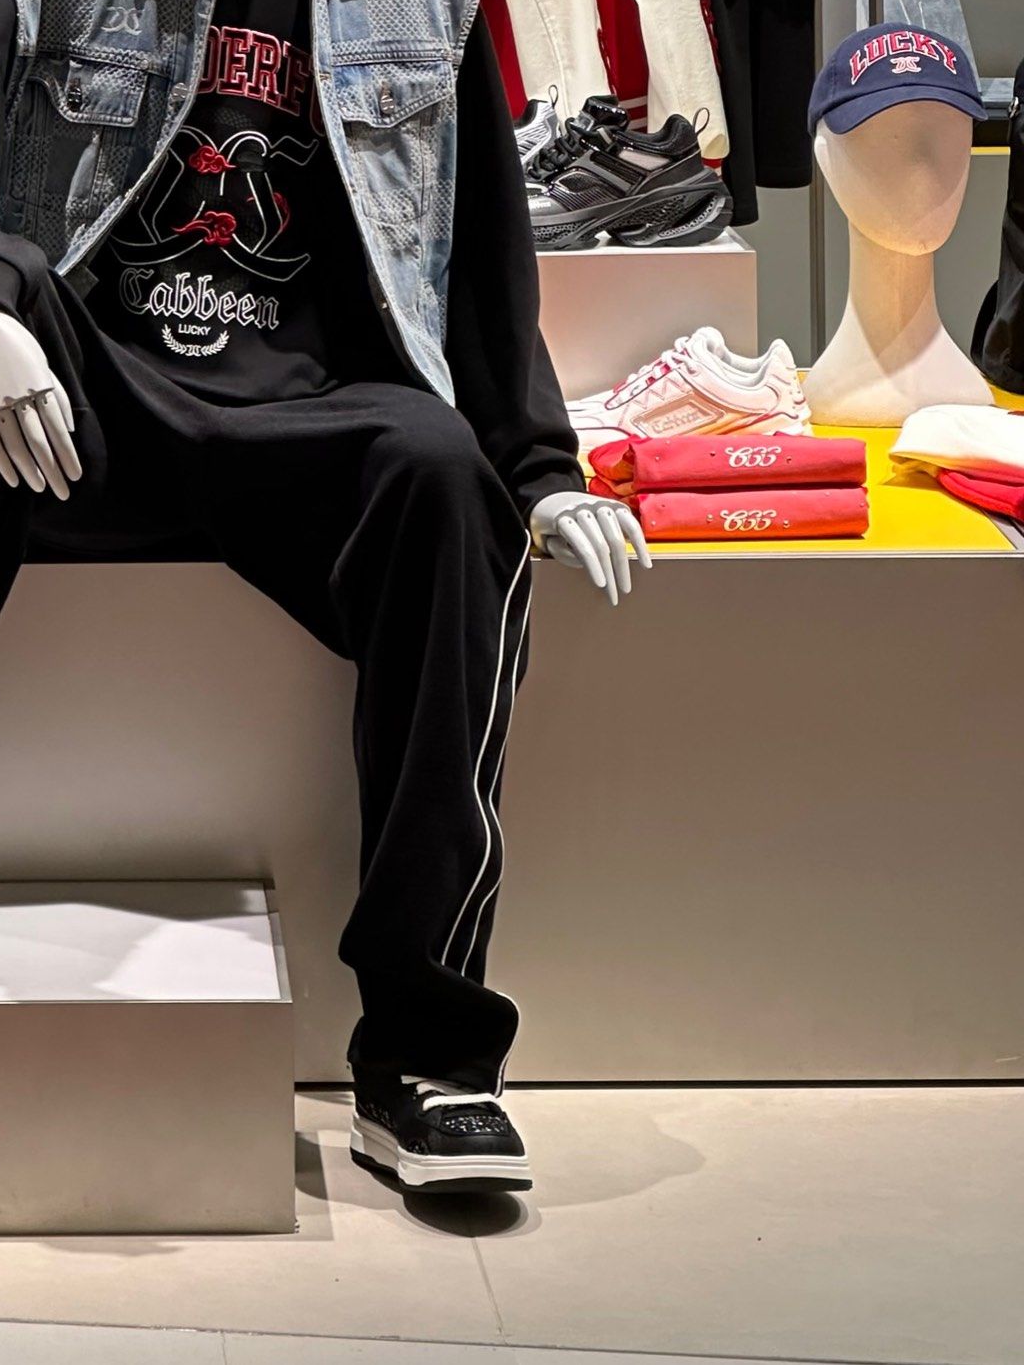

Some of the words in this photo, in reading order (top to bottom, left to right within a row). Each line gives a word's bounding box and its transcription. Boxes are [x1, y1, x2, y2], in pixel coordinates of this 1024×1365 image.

[849, 31, 957, 85] LUCKY
[119, 267, 279, 330] Cabbeen
[178, 323, 212, 336] LUCKY
